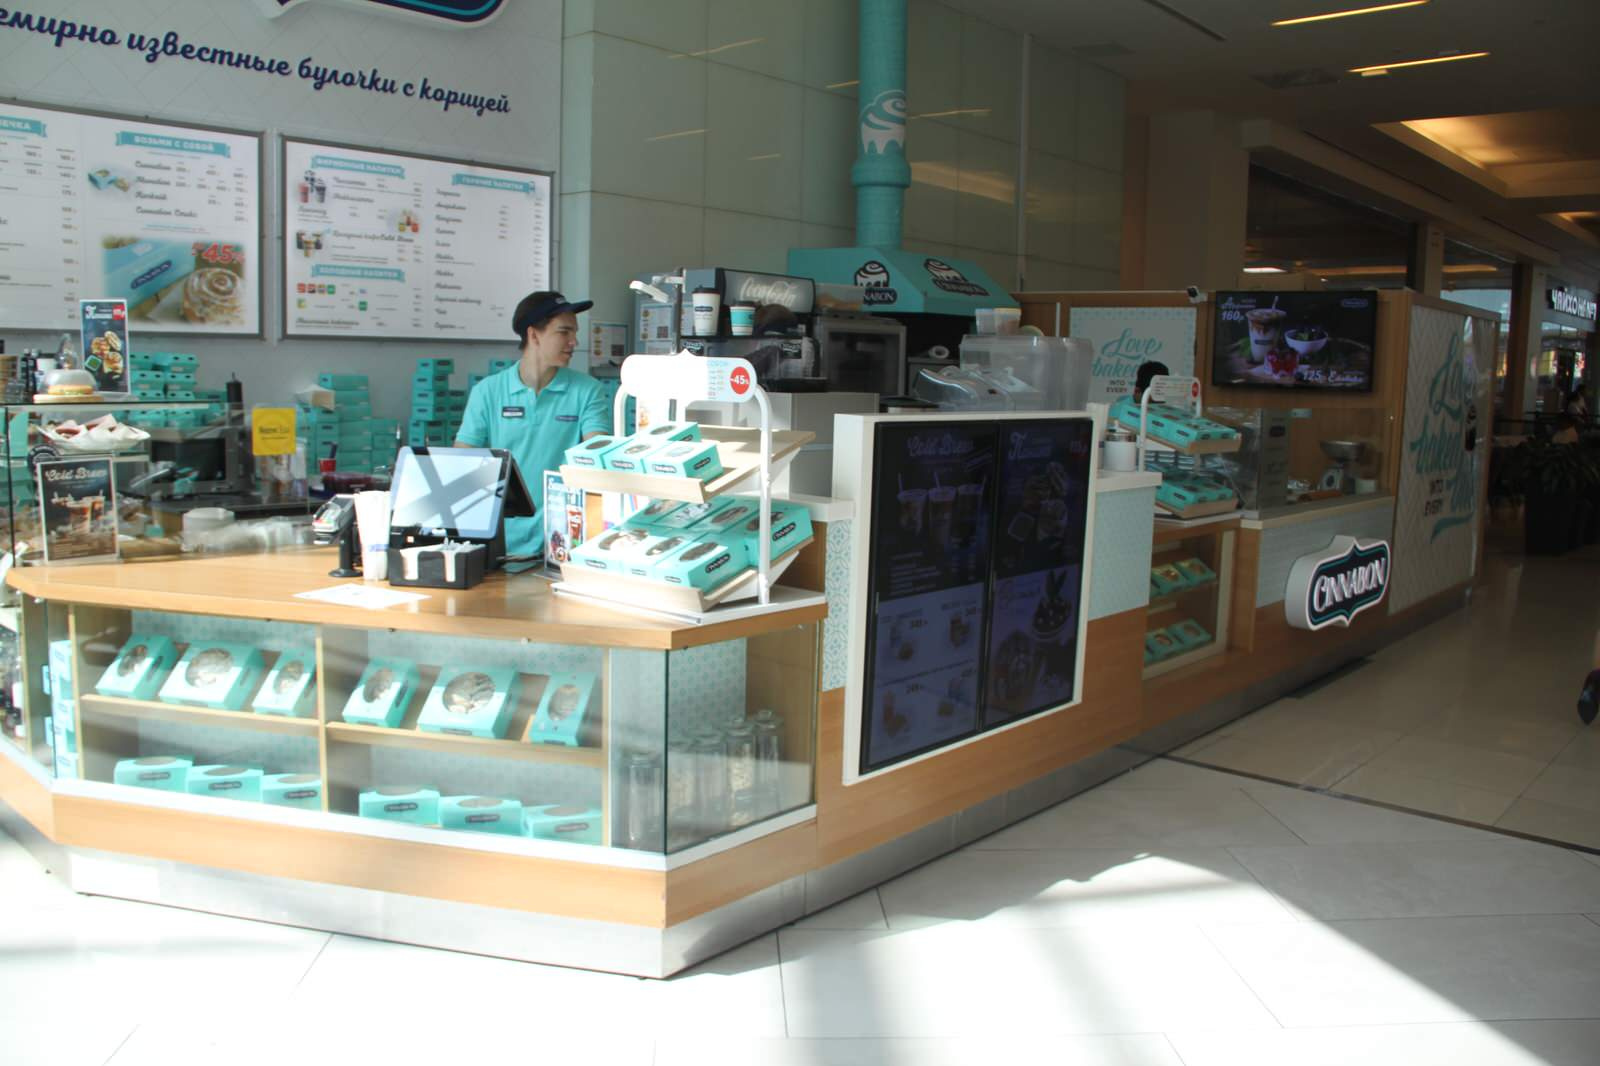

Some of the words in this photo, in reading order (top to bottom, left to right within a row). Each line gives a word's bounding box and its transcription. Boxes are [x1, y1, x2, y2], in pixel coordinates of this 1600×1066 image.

[127, 31, 293, 77] известные
[298, 57, 398, 95] булочки
[402, 81, 416, 97] с
[419, 77, 511, 118] корицей
[1102, 327, 1162, 360] Love
[1313, 557, 1386, 612] CINNABON
